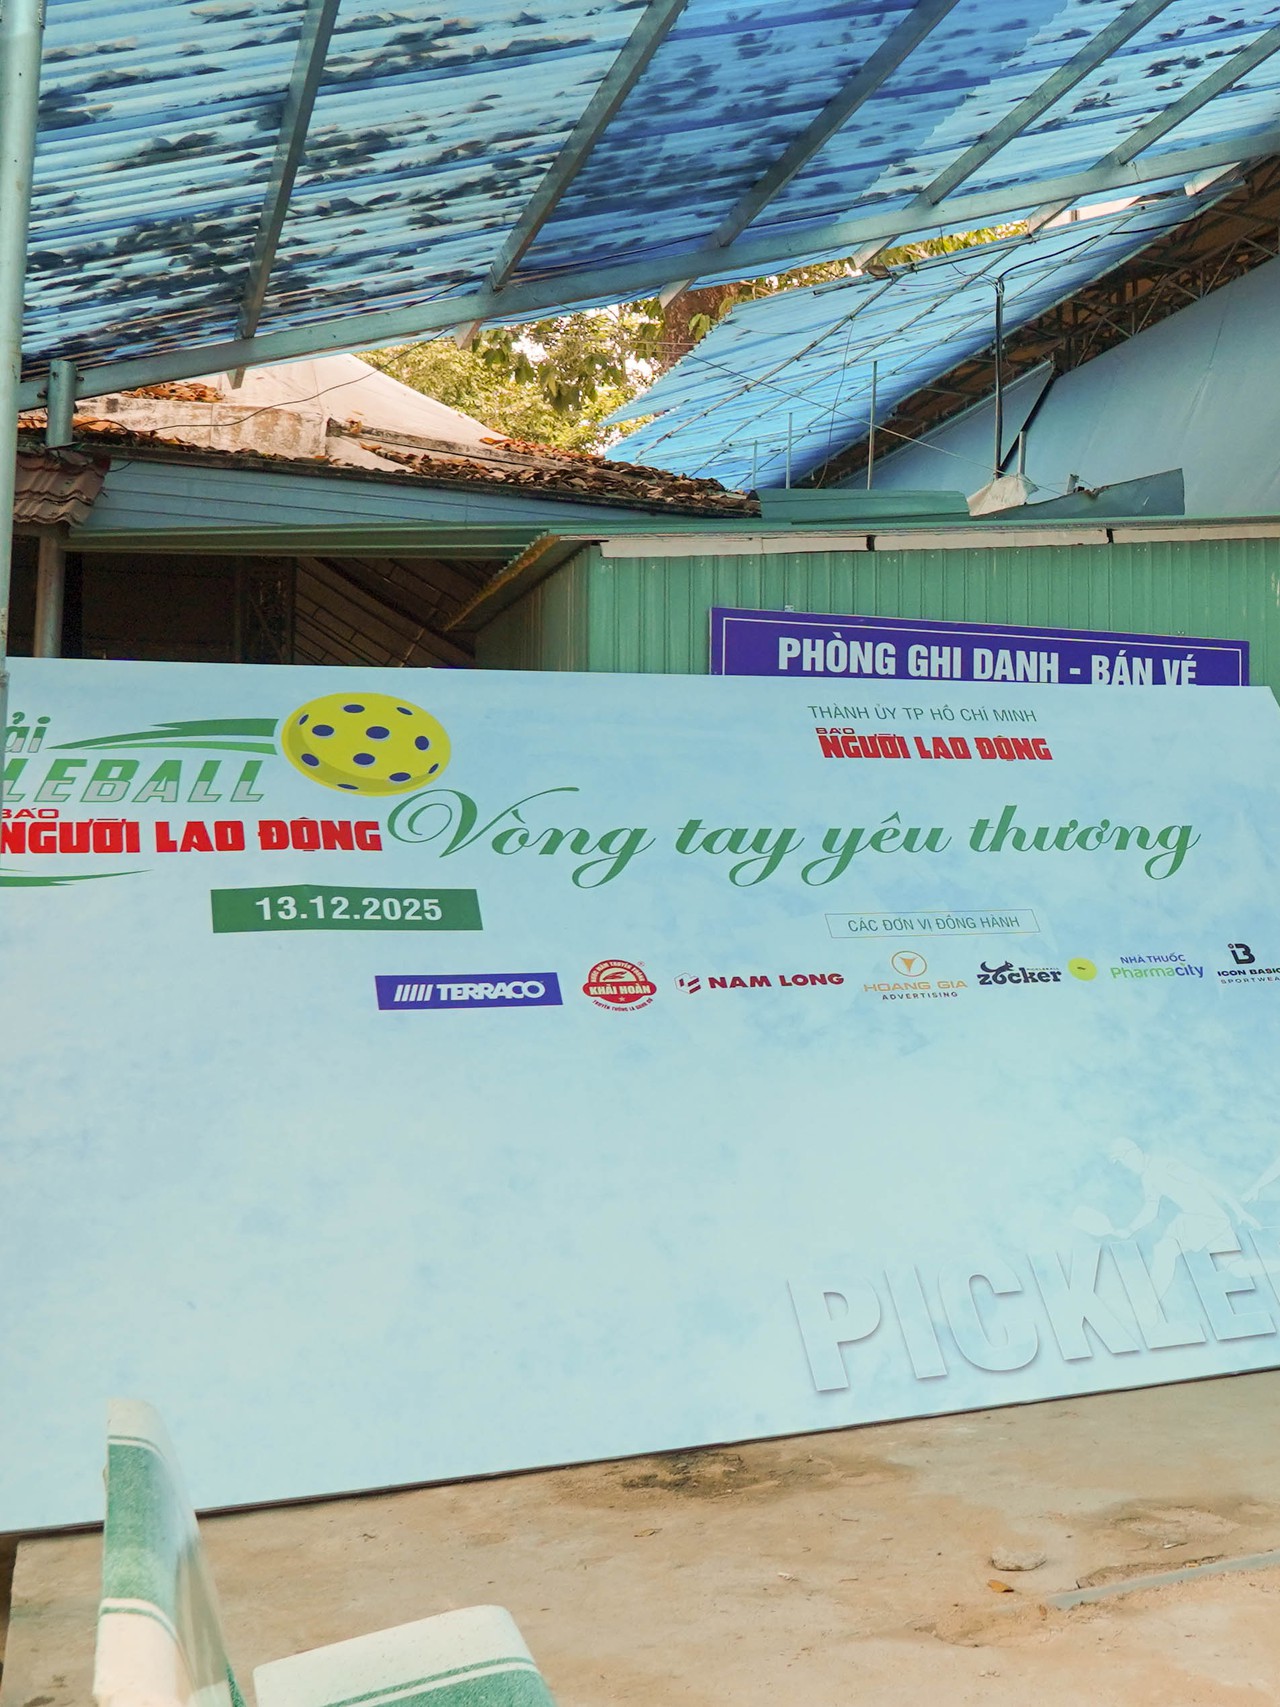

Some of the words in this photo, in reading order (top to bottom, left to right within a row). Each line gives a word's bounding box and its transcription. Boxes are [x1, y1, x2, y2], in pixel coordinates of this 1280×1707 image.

[778, 631, 897, 676] PHÒNG
[907, 644, 962, 679] GHI
[973, 647, 1059, 683] DANH
[1091, 649, 1154, 686] BÁN
[1162, 653, 1198, 686] VÉ
[807, 703, 870, 719] THÀNH
[903, 707, 924, 720] TP
[960, 706, 989, 721] CHÍ
[993, 709, 1037, 722] MINH
[815, 727, 856, 735] BÁO
[818, 733, 912, 759] NGƯỜI
[914, 736, 972, 759] LAO
[974, 734, 1053, 761] ĐỘNG
[0, 819, 140, 853] NGƯỜI
[155, 820, 246, 853] LAO
[258, 816, 383, 852] ĐỘNG
[386, 786, 656, 889] Vòng
[676, 816, 803, 888] tay
[801, 811, 951, 887] yêu
[969, 805, 1201, 881] thương
[255, 896, 443, 922] 13.12.2025
[848, 917, 879, 932] CÁC
[882, 916, 915, 931] ĐƠN
[917, 918, 933, 932] VỊ
[980, 913, 1020, 929] HÀNH
[1120, 954, 1148, 964] NHÀ
[1148, 953, 1186, 964] THUỐC
[1110, 962, 1204, 980] Pharmacity
[1217, 968, 1247, 977] ICON
[588, 983, 618, 995] KHẢI
[619, 983, 651, 995] HOÀN
[708, 975, 772, 989] NAM
[778, 972, 844, 988] LONG
[863, 981, 932, 992] HOANG
[937, 979, 968, 989] GIA
[436, 980, 546, 1001] TERRACO
[881, 991, 958, 1001] ADVERTISING
